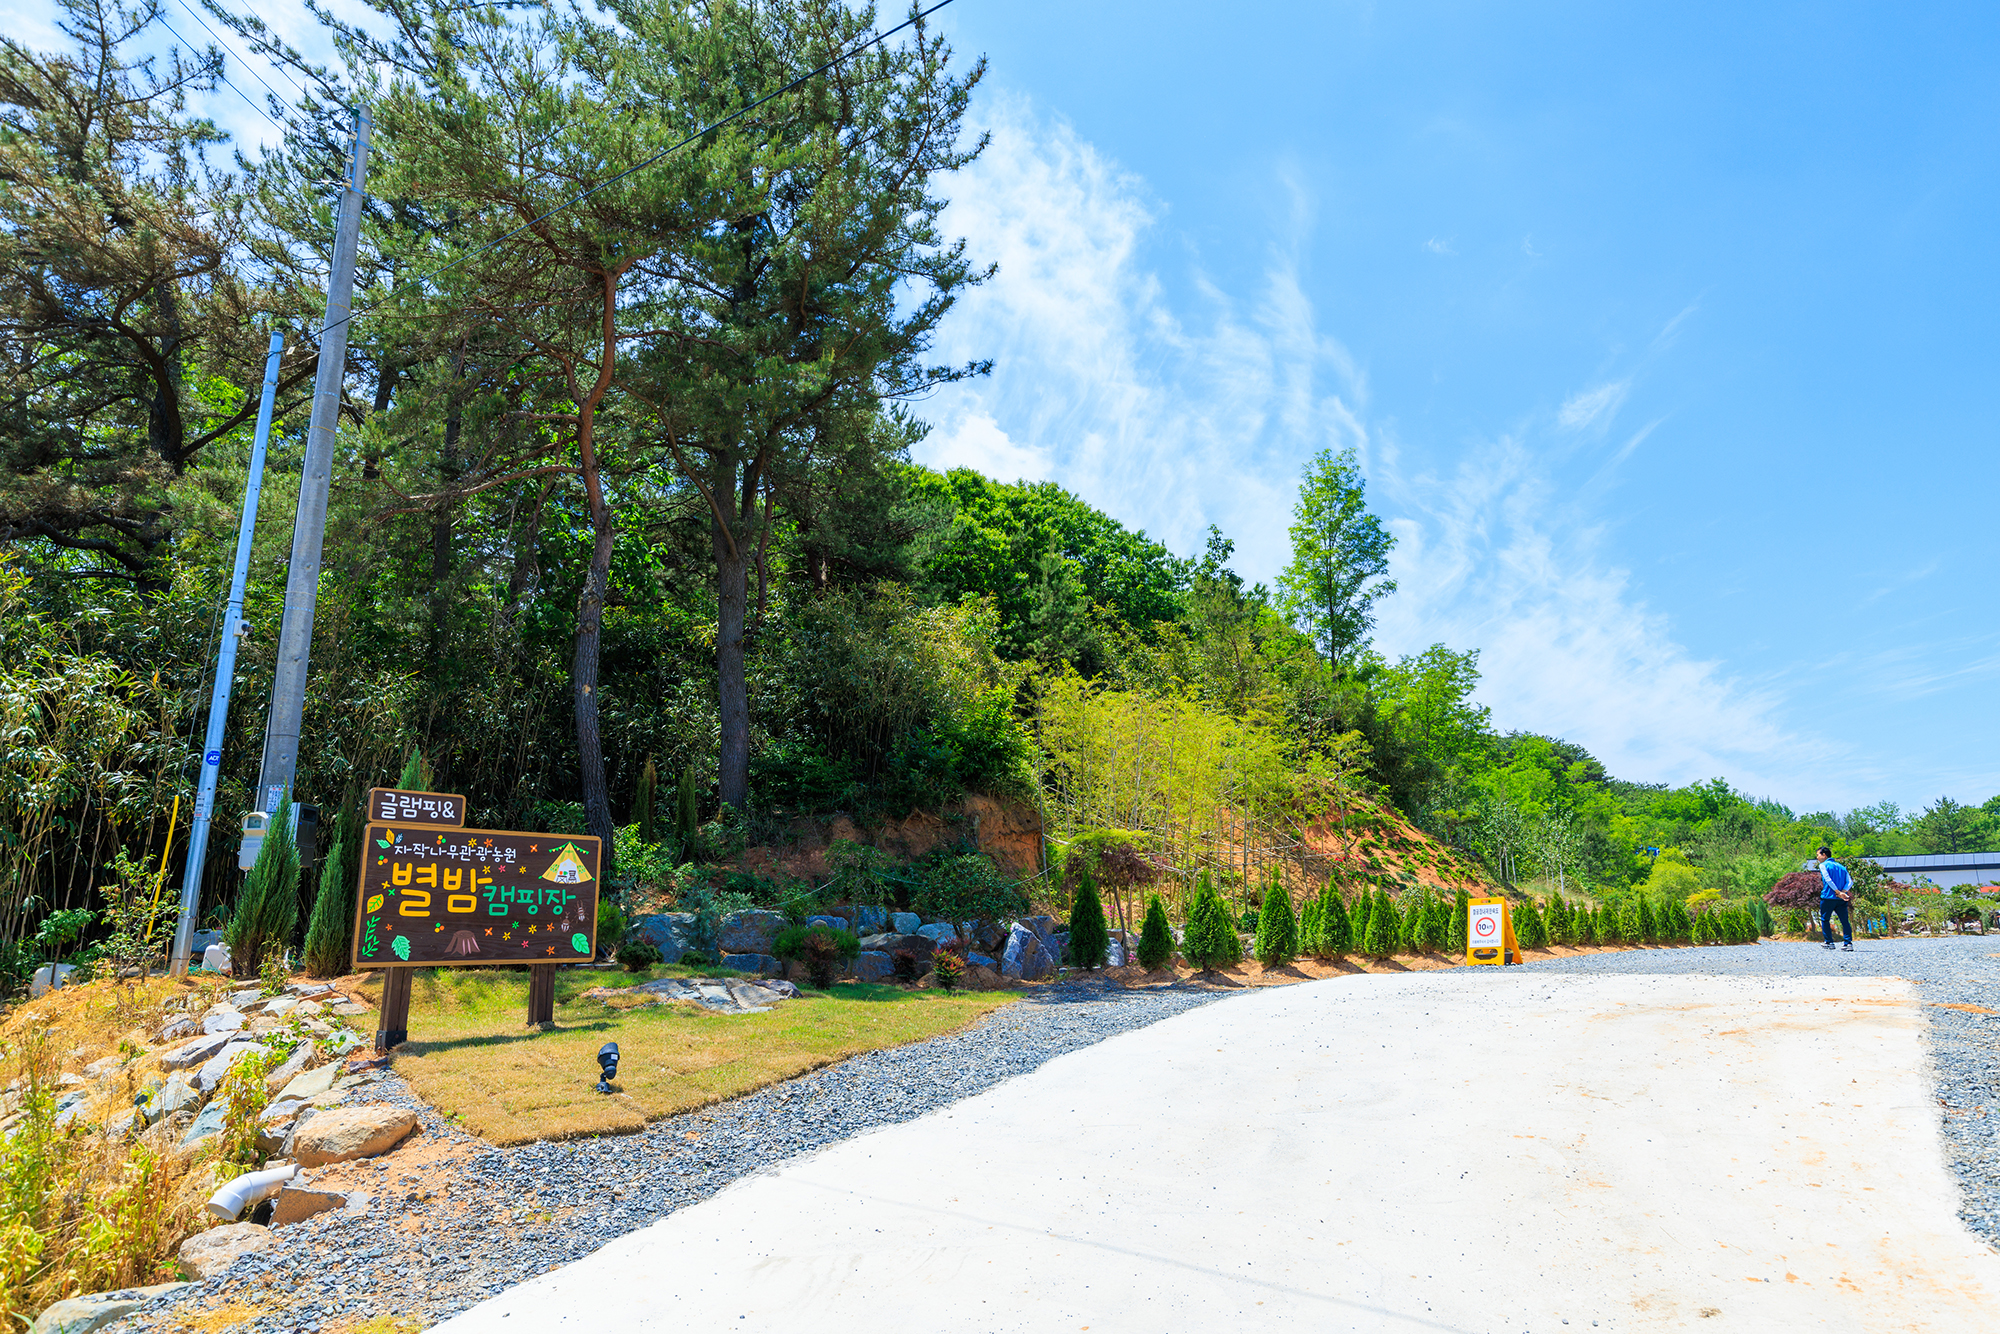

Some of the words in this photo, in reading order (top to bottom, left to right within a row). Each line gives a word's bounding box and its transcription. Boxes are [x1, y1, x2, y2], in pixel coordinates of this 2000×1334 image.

[380, 793, 455, 819] 글램핑&
[394, 843, 517, 863] 자작나무관광농원
[392, 862, 493, 917] 별밤
[482, 885, 576, 916] 캠핑장
